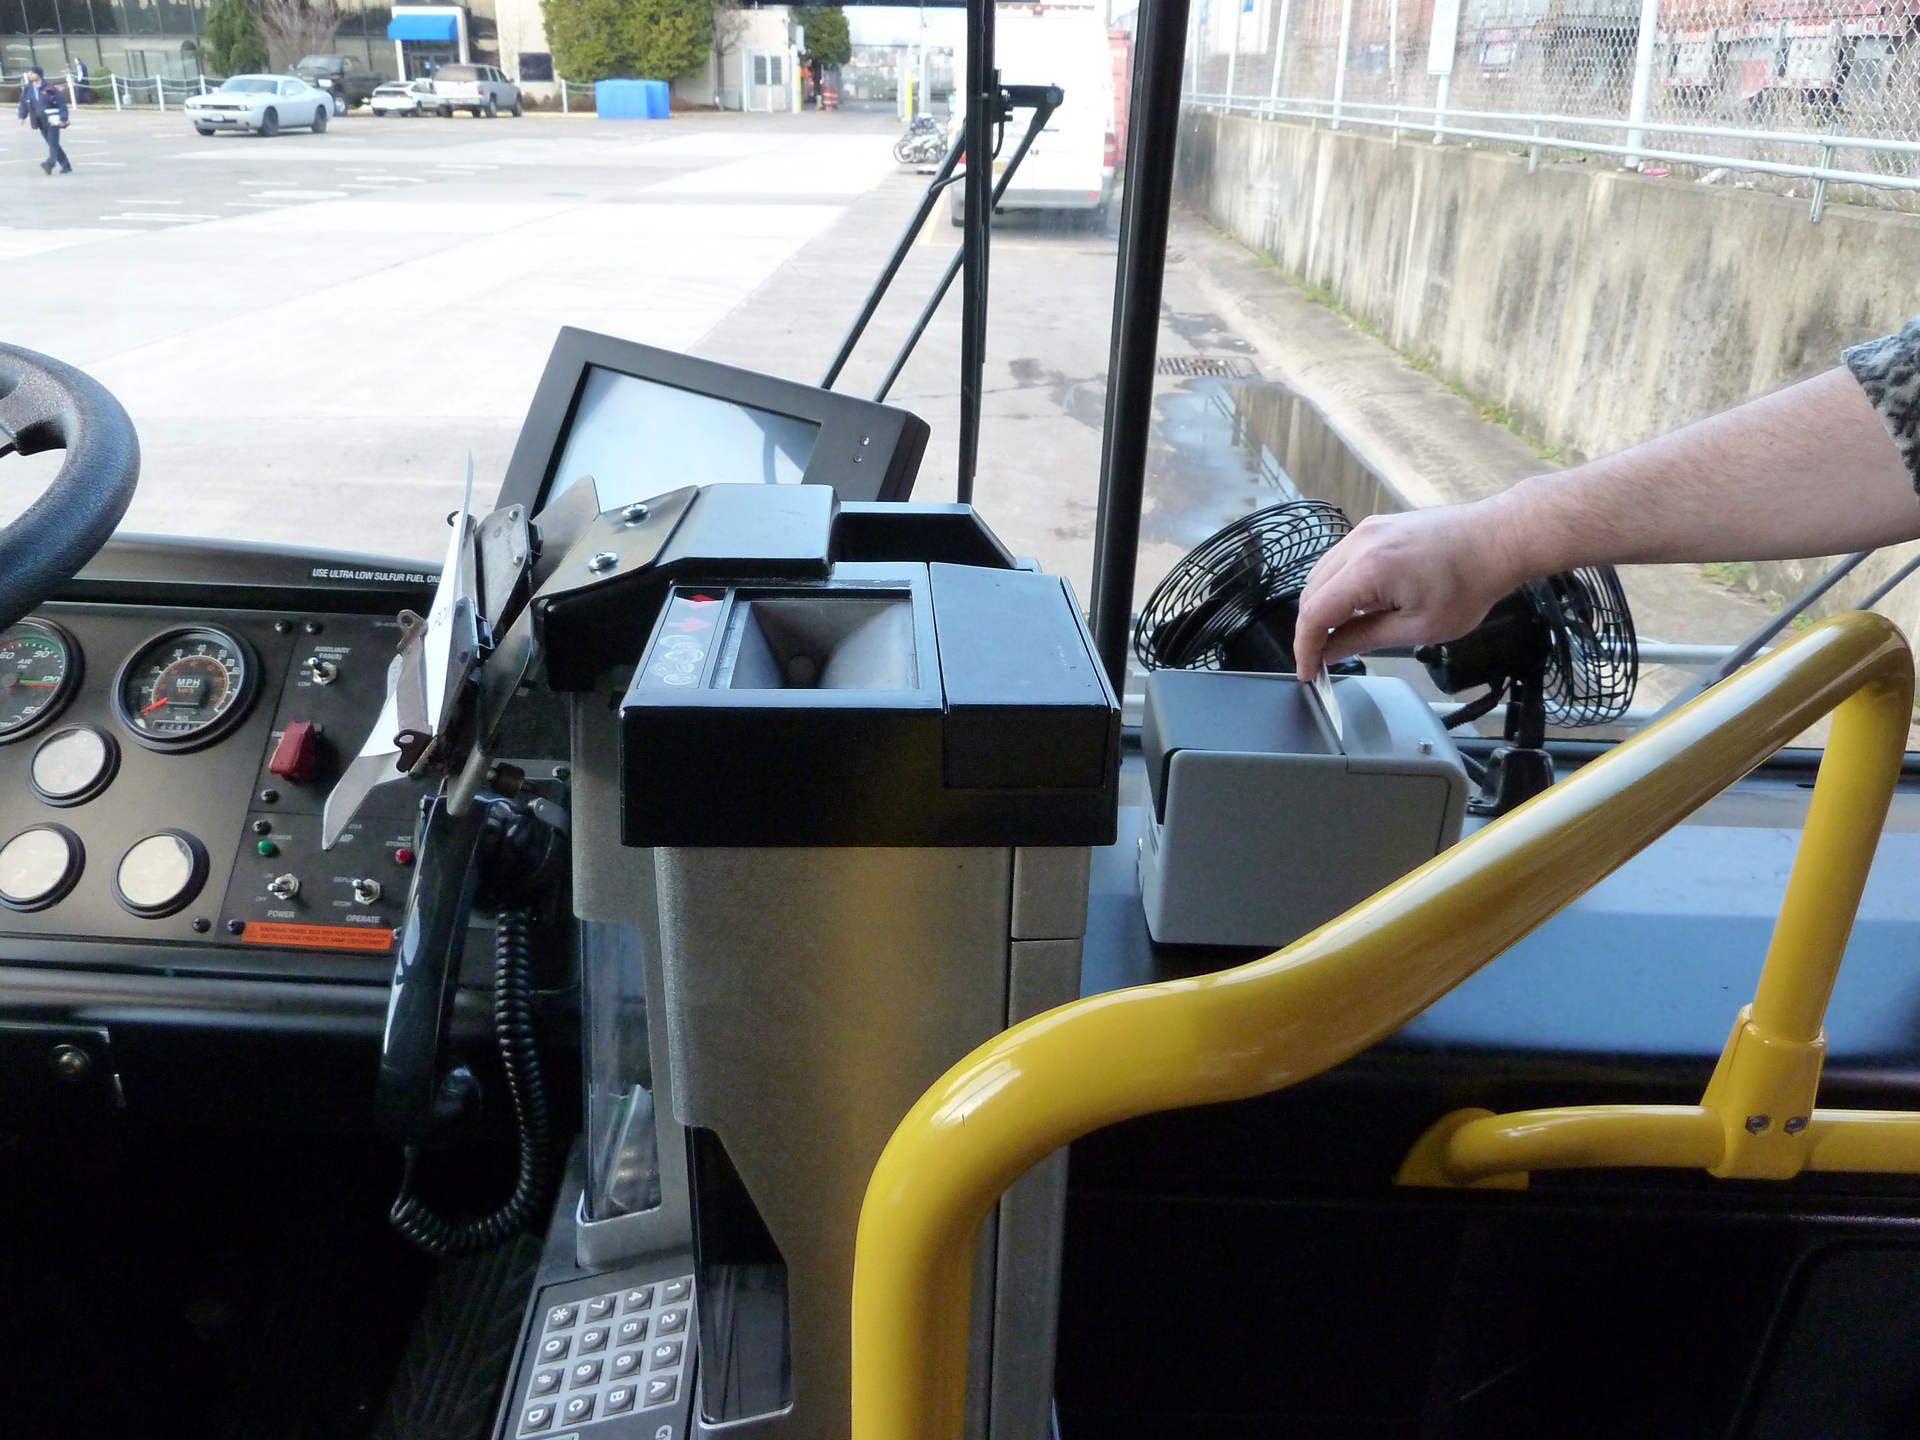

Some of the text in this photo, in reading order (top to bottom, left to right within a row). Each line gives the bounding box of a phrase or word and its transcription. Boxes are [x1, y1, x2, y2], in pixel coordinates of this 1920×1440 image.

[312, 568, 442, 583] USE ULTRA LOW SULFUR FUEL ONL
[33, 650, 51, 658] 90
[314, 645, 351, 653] AUXILIARY
[176, 678, 201, 686] MPH
[267, 909, 296, 919] POWER
[345, 914, 382, 923] OPERATE
[661, 1313, 676, 1324] 2
[609, 1291, 642, 1402] 4 5 6 B
[656, 1346, 671, 1357] 3
[568, 1300, 605, 1411] 7 8 9 C
[650, 1380, 666, 1393] A
[527, 1408, 544, 1422] D
